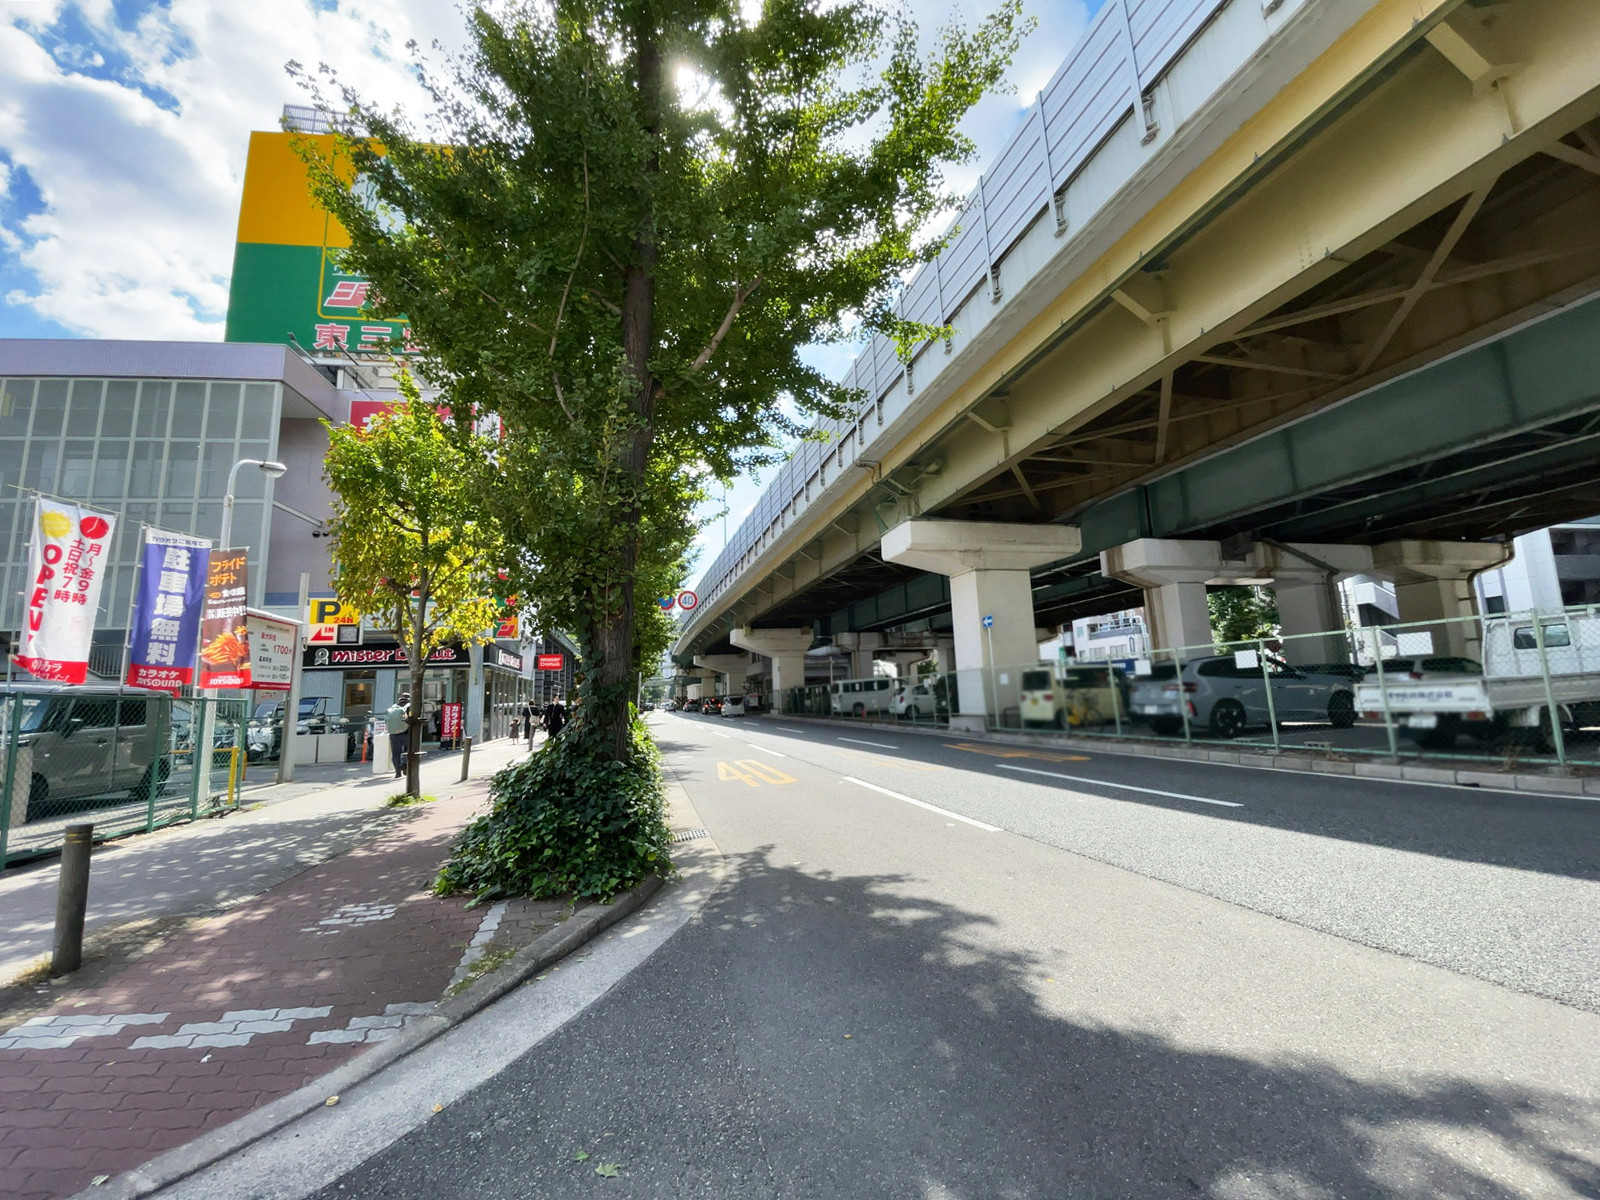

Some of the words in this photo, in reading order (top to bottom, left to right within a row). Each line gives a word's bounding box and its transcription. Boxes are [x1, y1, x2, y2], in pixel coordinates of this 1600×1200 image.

[54, 538, 85, 603] 土日祝7時
[210, 556, 246, 573] フライド
[209, 572, 237, 587] ポテト
[146, 547, 191, 665] 駐車場無料
[682, 596, 693, 605] 40
[318, 601, 341, 623] P
[334, 616, 354, 624] 24H
[331, 650, 394, 662] mister
[138, 668, 179, 679] カラオケ
[716, 759, 798, 787] 40
